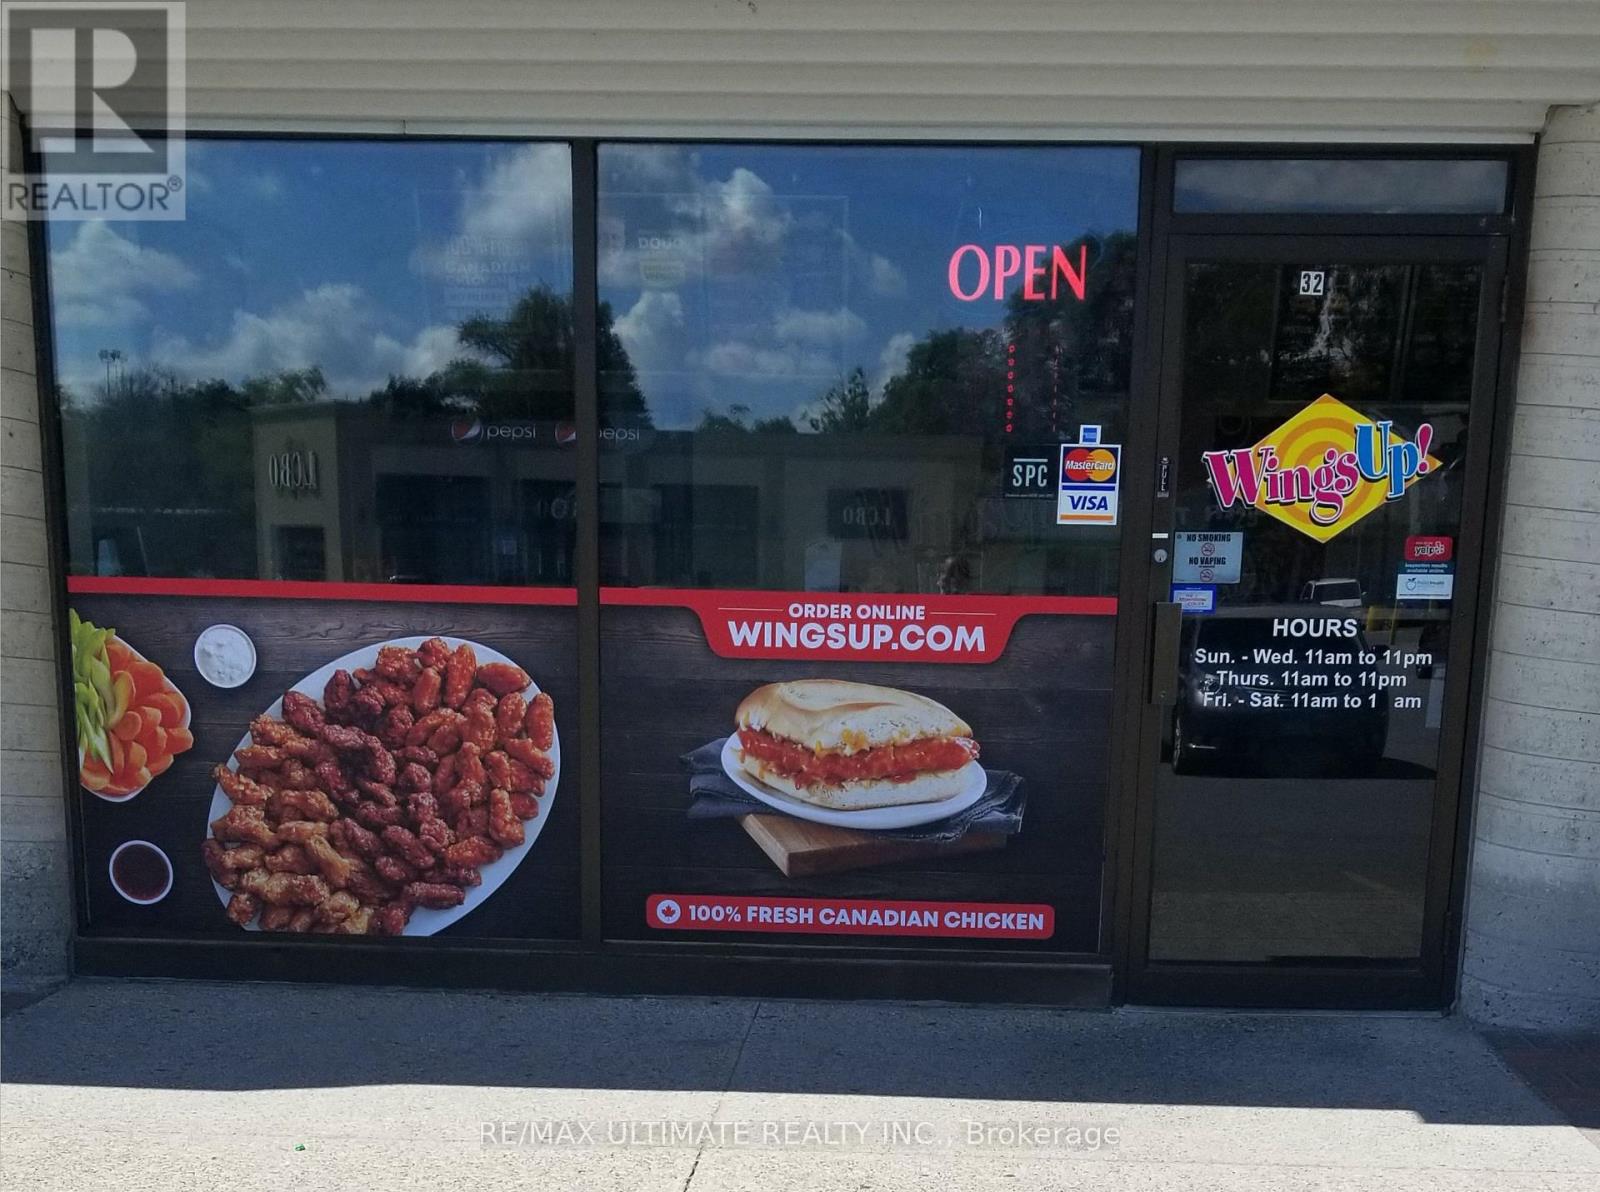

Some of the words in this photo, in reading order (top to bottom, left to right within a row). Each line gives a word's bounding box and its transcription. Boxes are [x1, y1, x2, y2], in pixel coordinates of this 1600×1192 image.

[948, 245, 1087, 301] OPEN
[1302, 272, 1323, 293] 32
[486, 425, 536, 441] pepsi
[599, 427, 640, 443] epsi
[1065, 459, 1116, 471] MasterCard
[1012, 464, 1048, 488] SPC
[1067, 495, 1109, 511] VISA
[1186, 533, 1197, 542] NO
[1198, 534, 1231, 543] SMOKING
[1189, 557, 1199, 565] NO
[1200, 557, 1227, 566] VAPING
[788, 603, 852, 619] ORDER
[856, 604, 926, 620] ONLINE
[727, 620, 986, 652] WINGSUP.COM
[1273, 619, 1358, 637] HOURS
[1194, 648, 1236, 664] Sun.
[1254, 649, 1298, 665] Wed.
[1306, 650, 1352, 665] 11am
[1359, 651, 1376, 665] to
[1383, 650, 1433, 669] 11pm
[1216, 670, 1274, 686] Thurs.
[1281, 671, 1328, 687] 11am
[1334, 672, 1352, 687] to
[1358, 672, 1407, 690] 11pm
[1203, 692, 1232, 707] Fri.
[1250, 692, 1284, 708] Sat.
[1292, 693, 1338, 708] 11am
[1344, 694, 1362, 708] to
[1368, 694, 1376, 708] 1
[1394, 696, 1422, 708] am
[688, 904, 742, 922] 100%
[747, 906, 813, 924] FRESH
[819, 908, 939, 928] CANADIAN
[944, 911, 1044, 930] CHICKEN
